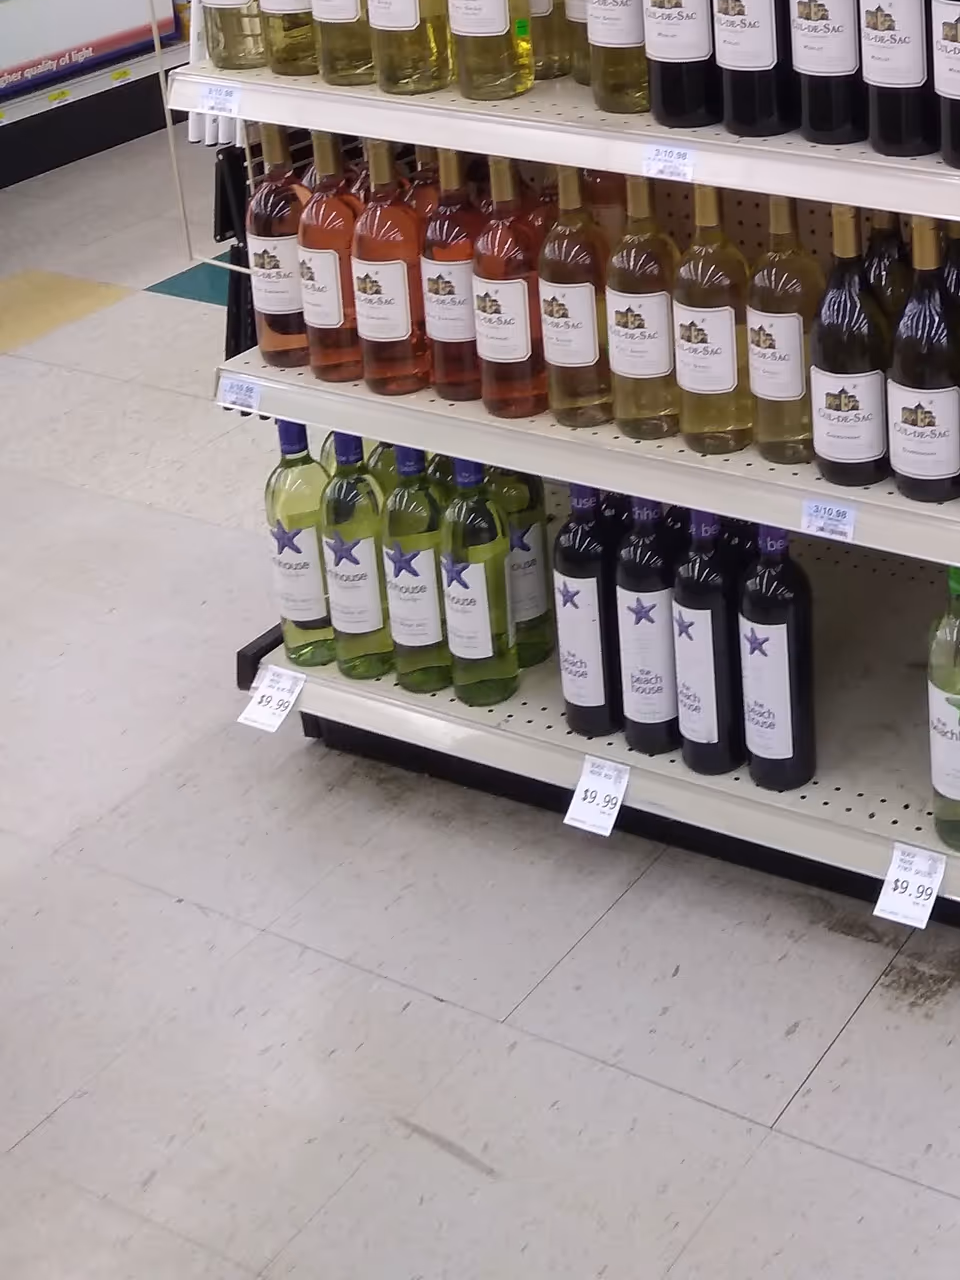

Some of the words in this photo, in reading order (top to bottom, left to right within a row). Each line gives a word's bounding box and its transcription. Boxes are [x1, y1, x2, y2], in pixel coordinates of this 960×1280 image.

[24, 59, 57, 79] quality
[60, 52, 69, 66] of
[71, 47, 95, 63] light
[818, 408, 873, 423] CUL-DE-SAC
[894, 422, 950, 439] CUL-DE-SAC
[813, 505, 848, 519] 3/10.98
[630, 673, 663, 685] beach
[631, 683, 663, 694] house
[258, 694, 290, 712] $9.99
[582, 788, 618, 810] $9.99
[892, 878, 934, 901] $9.99
